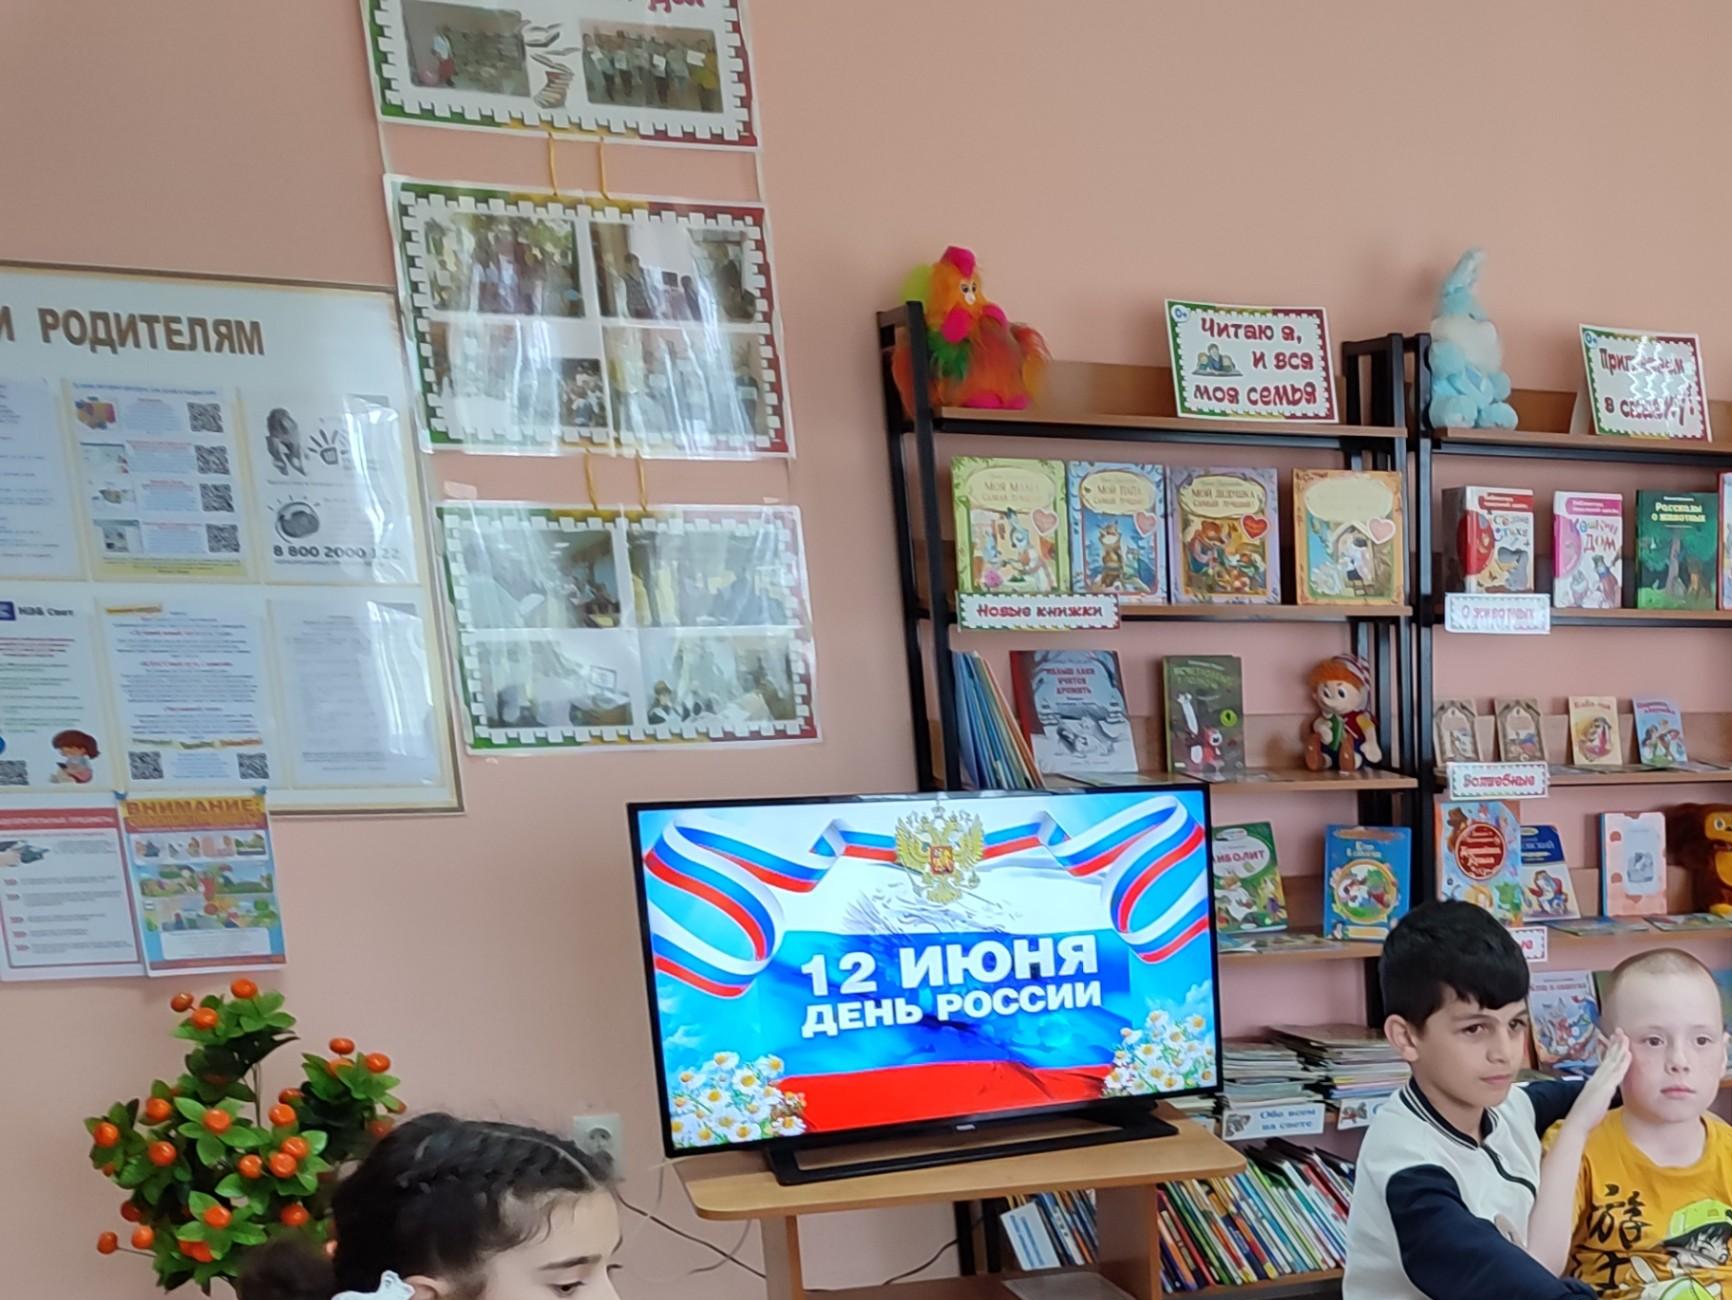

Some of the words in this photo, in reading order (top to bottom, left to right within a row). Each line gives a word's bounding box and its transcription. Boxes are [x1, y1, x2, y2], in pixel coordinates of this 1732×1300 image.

[37, 308, 265, 356] РОДИТЕЛЯМ
[1201, 318, 1274, 341] Читаю
[1281, 325, 1302, 344] я,
[1274, 352, 1314, 370] вся
[1194, 384, 1240, 404] моя
[1247, 382, 1317, 406] семья
[273, 545, 283, 557] 8
[288, 545, 320, 558] 800
[324, 545, 367, 558] 2000
[976, 603, 1031, 617] Новые
[1036, 604, 1102, 617] книжки
[801, 951, 878, 998] 12
[899, 934, 1099, 990] ИЮНЯ
[801, 1001, 923, 1040] ДЕНЬ
[937, 980, 1102, 1022] РОССИИ
